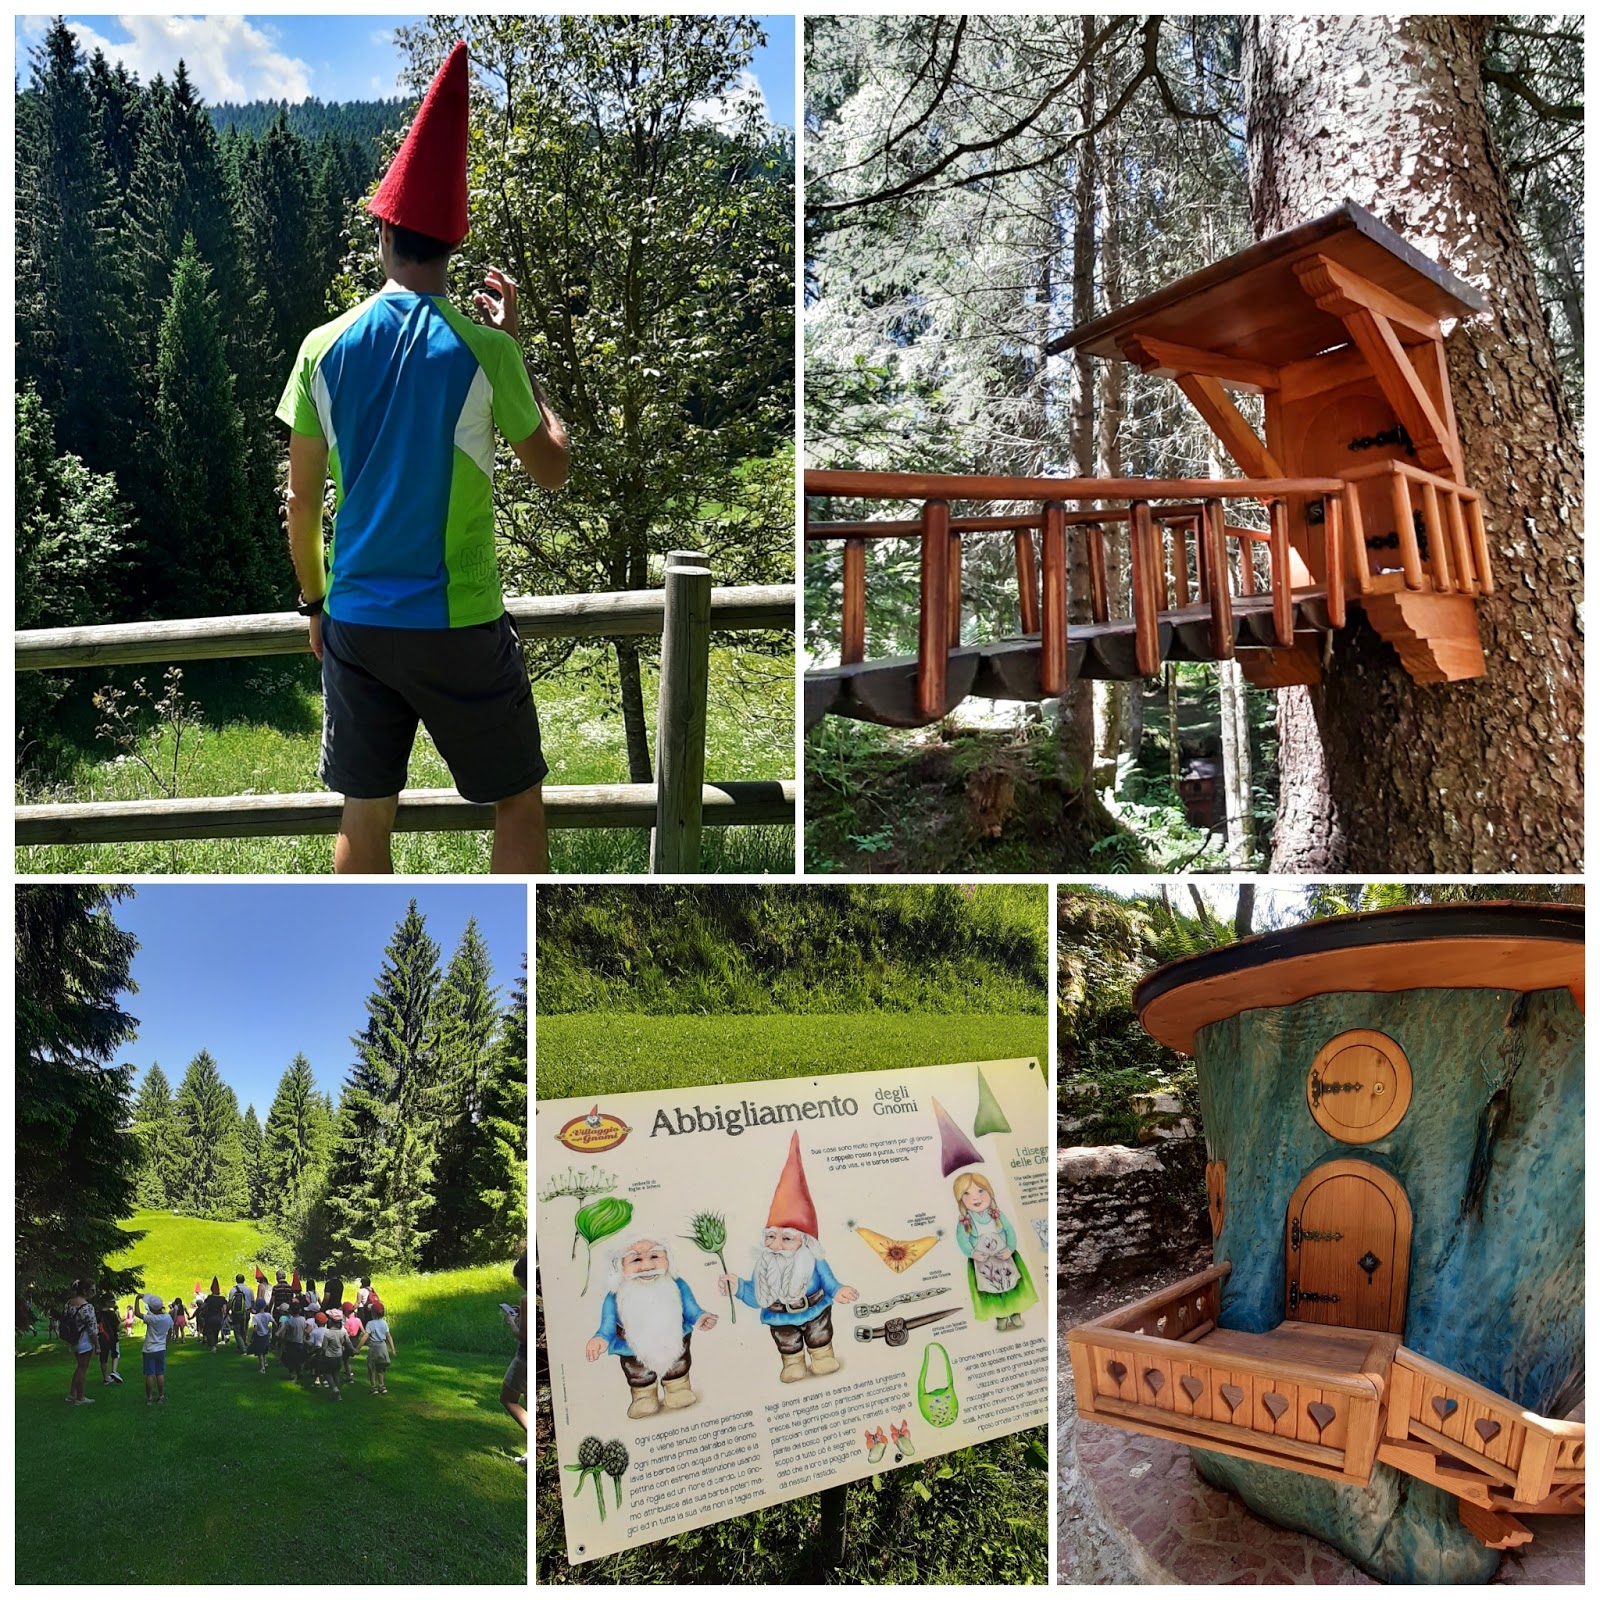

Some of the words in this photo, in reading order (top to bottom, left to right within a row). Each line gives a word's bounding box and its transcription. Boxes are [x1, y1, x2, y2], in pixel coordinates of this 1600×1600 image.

[873, 1100, 918, 1116] Gnomi
[875, 1086, 909, 1102] degli
[572, 1127, 619, 1136] Villaggio
[649, 1095, 858, 1137] Abbigliamento
[583, 1133, 618, 1144] Gnomi
[1010, 1158, 1032, 1168] delle
[635, 1434, 650, 1446] Ogni
[652, 1428, 679, 1442] cappello
[701, 1418, 719, 1428] nome
[721, 1410, 752, 1426] personale
[656, 1441, 674, 1450] viene
[676, 1436, 697, 1446] tenuto
[699, 1432, 711, 1441] con
[713, 1426, 736, 1439] grande
[630, 1472, 644, 1483] lava
[646, 1469, 652, 1478] la
[654, 1466, 675, 1477] barba
[677, 1462, 689, 1470] con
[691, 1455, 712, 1466] acqua
[721, 1447, 745, 1458] ruscello
[634, 1460, 649, 1471] Ogni
[651, 1451, 676, 1465] mattina
[678, 1447, 698, 1461] prima
[727, 1437, 733, 1445] lo
[734, 1432, 756, 1442] Gnomo
[630, 1484, 654, 1498] pettina
[656, 1480, 669, 1488] con
[671, 1472, 700, 1484] estrema
[702, 1461, 735, 1476] attenzione
[737, 1454, 760, 1466] usando
[630, 1512, 641, 1521] mo
[644, 1501, 679, 1516] attribuisce
[682, 1496, 693, 1506] alla
[695, 1494, 706, 1502] sua
[708, 1486, 729, 1498] barba
[731, 1482, 749, 1495] poteri
[631, 1497, 644, 1508] una
[646, 1493, 665, 1505] foglia
[667, 1488, 676, 1498] ed
[678, 1486, 686, 1495] un
[688, 1481, 705, 1492] fiore
[707, 1478, 713, 1486] di
[628, 1526, 638, 1537] gici
[640, 1522, 650, 1530] ed
[651, 1519, 658, 1527] in
[660, 1514, 675, 1525] tutta
[677, 1512, 684, 1520] la
[685, 1508, 697, 1518] sua
[700, 1504, 711, 1513] vita
[713, 1500, 726, 1509] non
[728, 1496, 733, 1504] la
[735, 1493, 751, 1504] taglia
